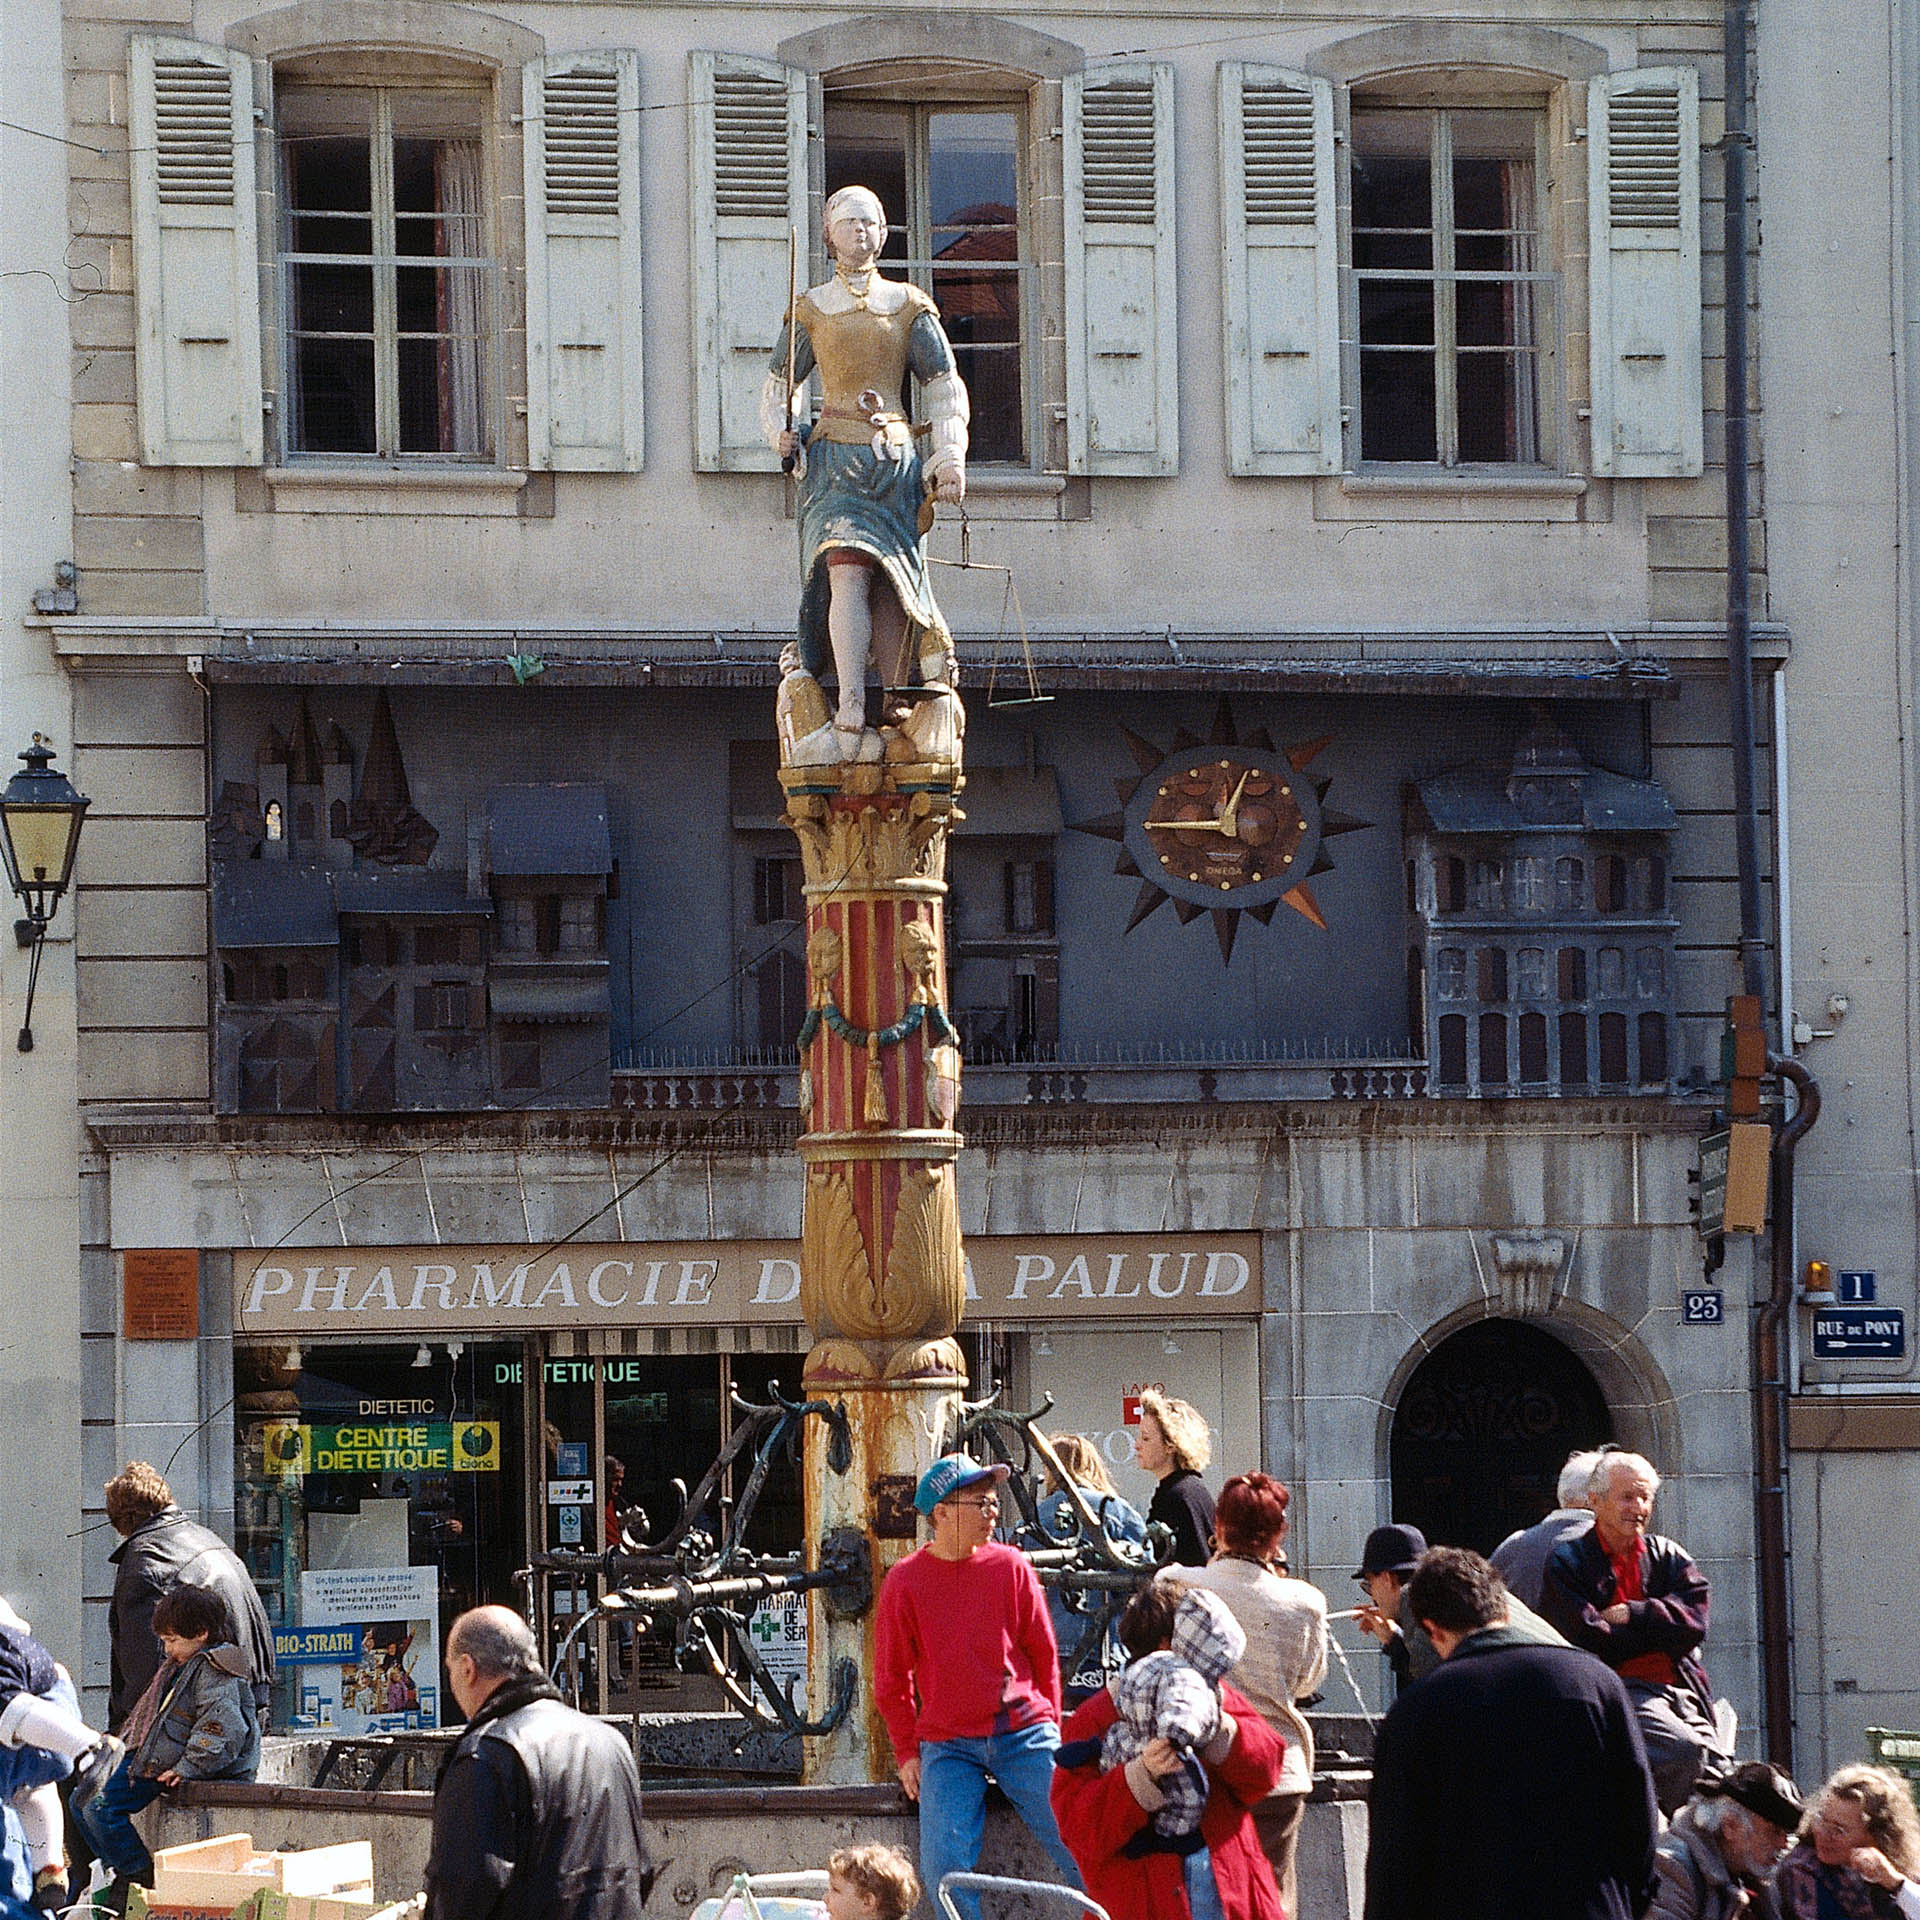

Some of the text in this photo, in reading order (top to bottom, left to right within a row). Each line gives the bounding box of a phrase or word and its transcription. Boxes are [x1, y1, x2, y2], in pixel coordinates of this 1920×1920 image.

[242, 1260, 719, 1313] PHARMACIE
[750, 1259, 801, 1304] D
[1006, 1252, 1250, 1299] PALUD
[1853, 1276, 1863, 1299] 1
[1689, 1296, 1718, 1319] 23
[1817, 1321, 1900, 1336] RUE DU PONT
[359, 1399, 435, 1415] DIETETIC
[335, 1427, 428, 1448] CENTRE
[317, 1448, 448, 1471] DIETETIQUE
[784, 1610, 799, 1625] DE
[275, 1632, 354, 1654] BIO-STRATH
